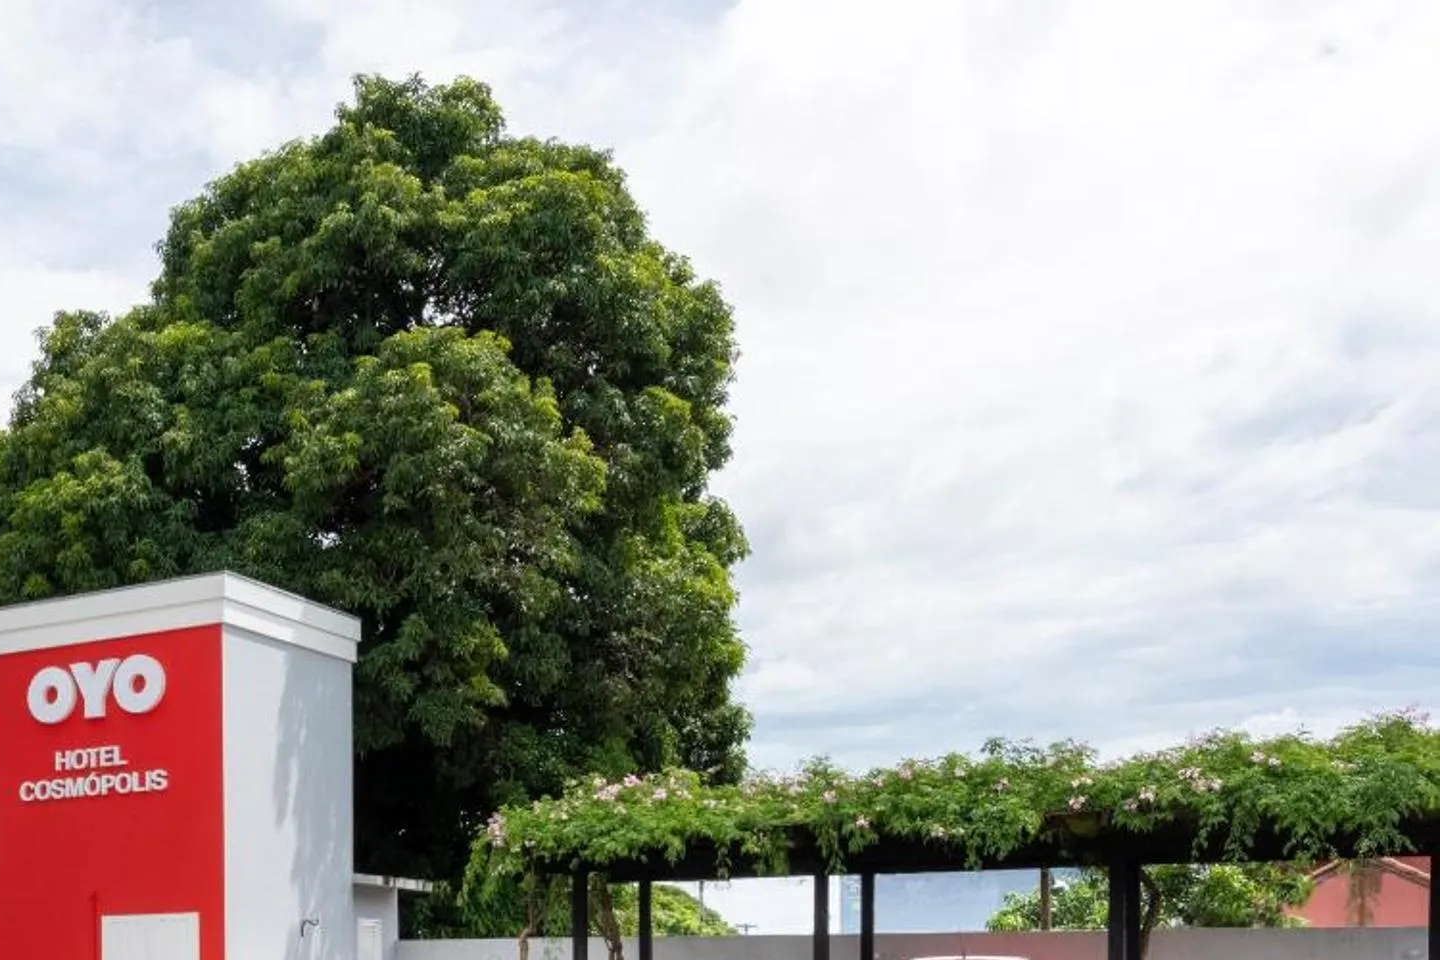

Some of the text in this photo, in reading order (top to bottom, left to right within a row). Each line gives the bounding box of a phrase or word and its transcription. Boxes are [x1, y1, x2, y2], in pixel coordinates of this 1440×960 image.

[26, 653, 166, 724] OYO
[55, 745, 128, 771] HOTEL
[19, 769, 168, 802] COSMÓPOLIS
